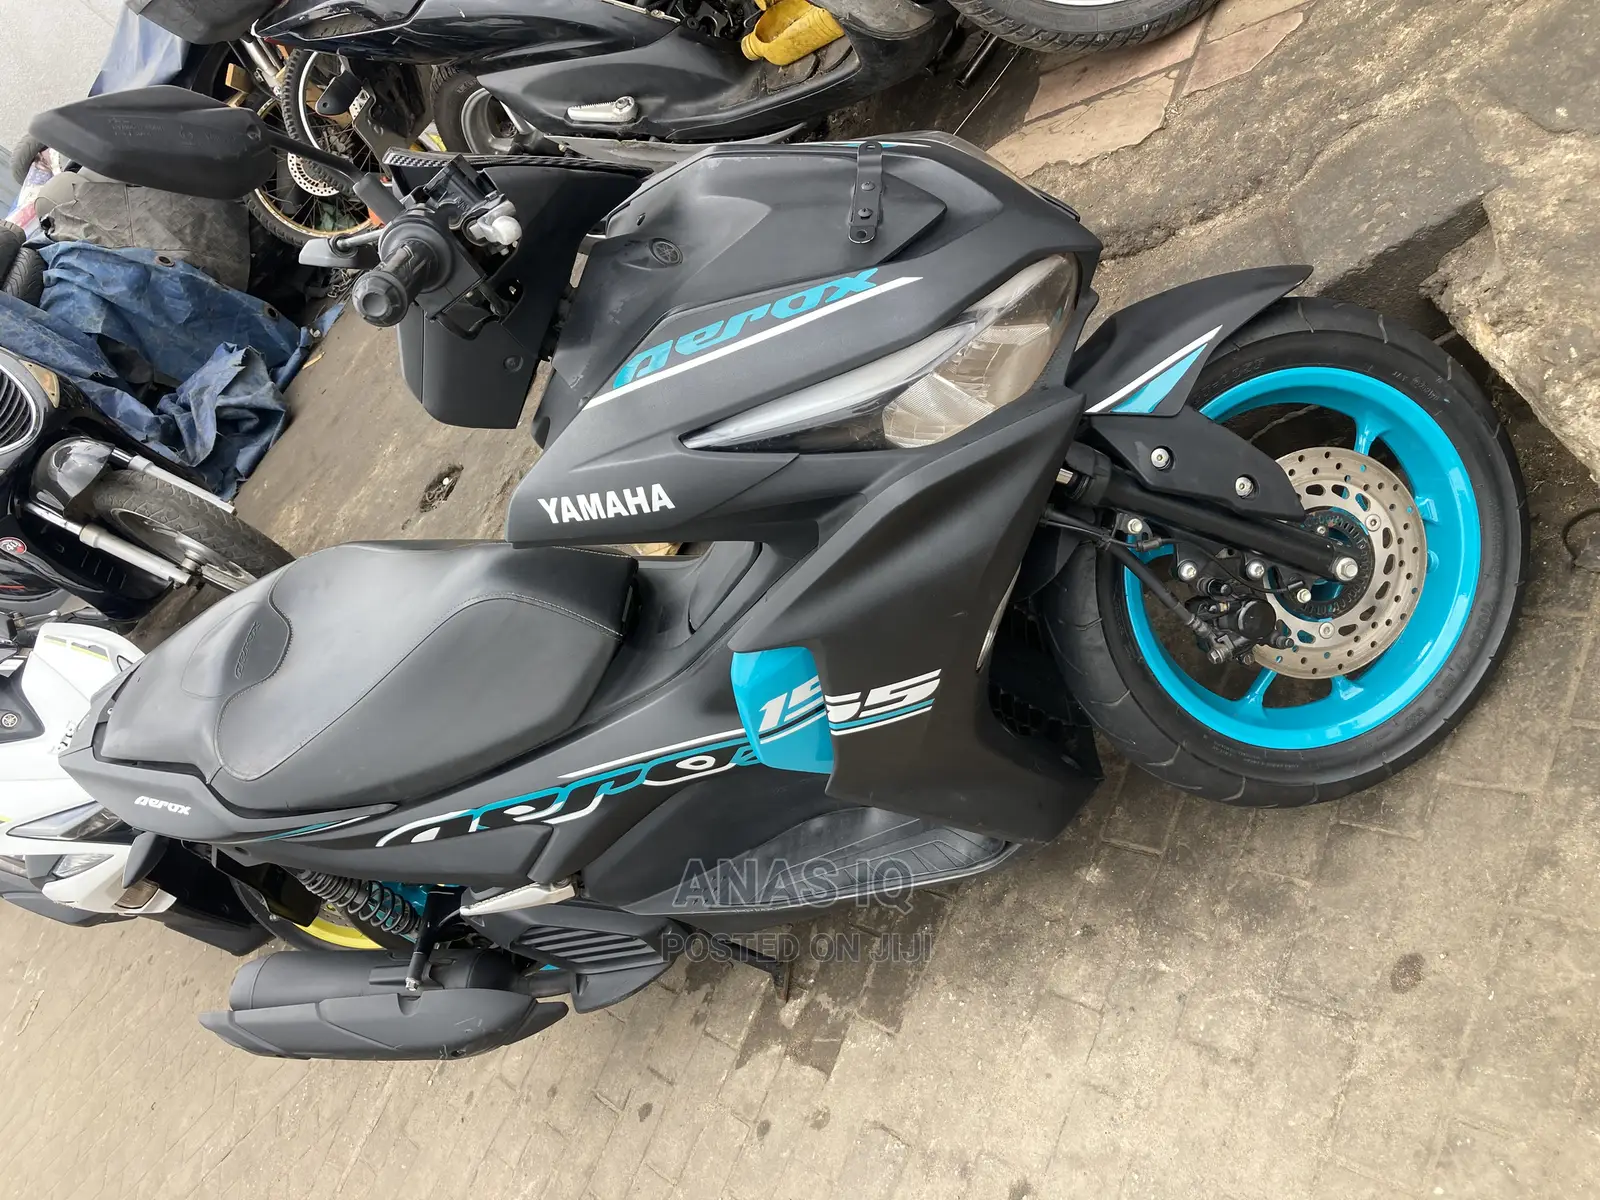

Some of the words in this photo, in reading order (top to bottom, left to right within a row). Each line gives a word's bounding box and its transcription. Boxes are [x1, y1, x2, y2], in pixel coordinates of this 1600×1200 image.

[613, 267, 879, 390] aerox
[537, 483, 676, 524] YAMAHA
[758, 668, 942, 732] 155
